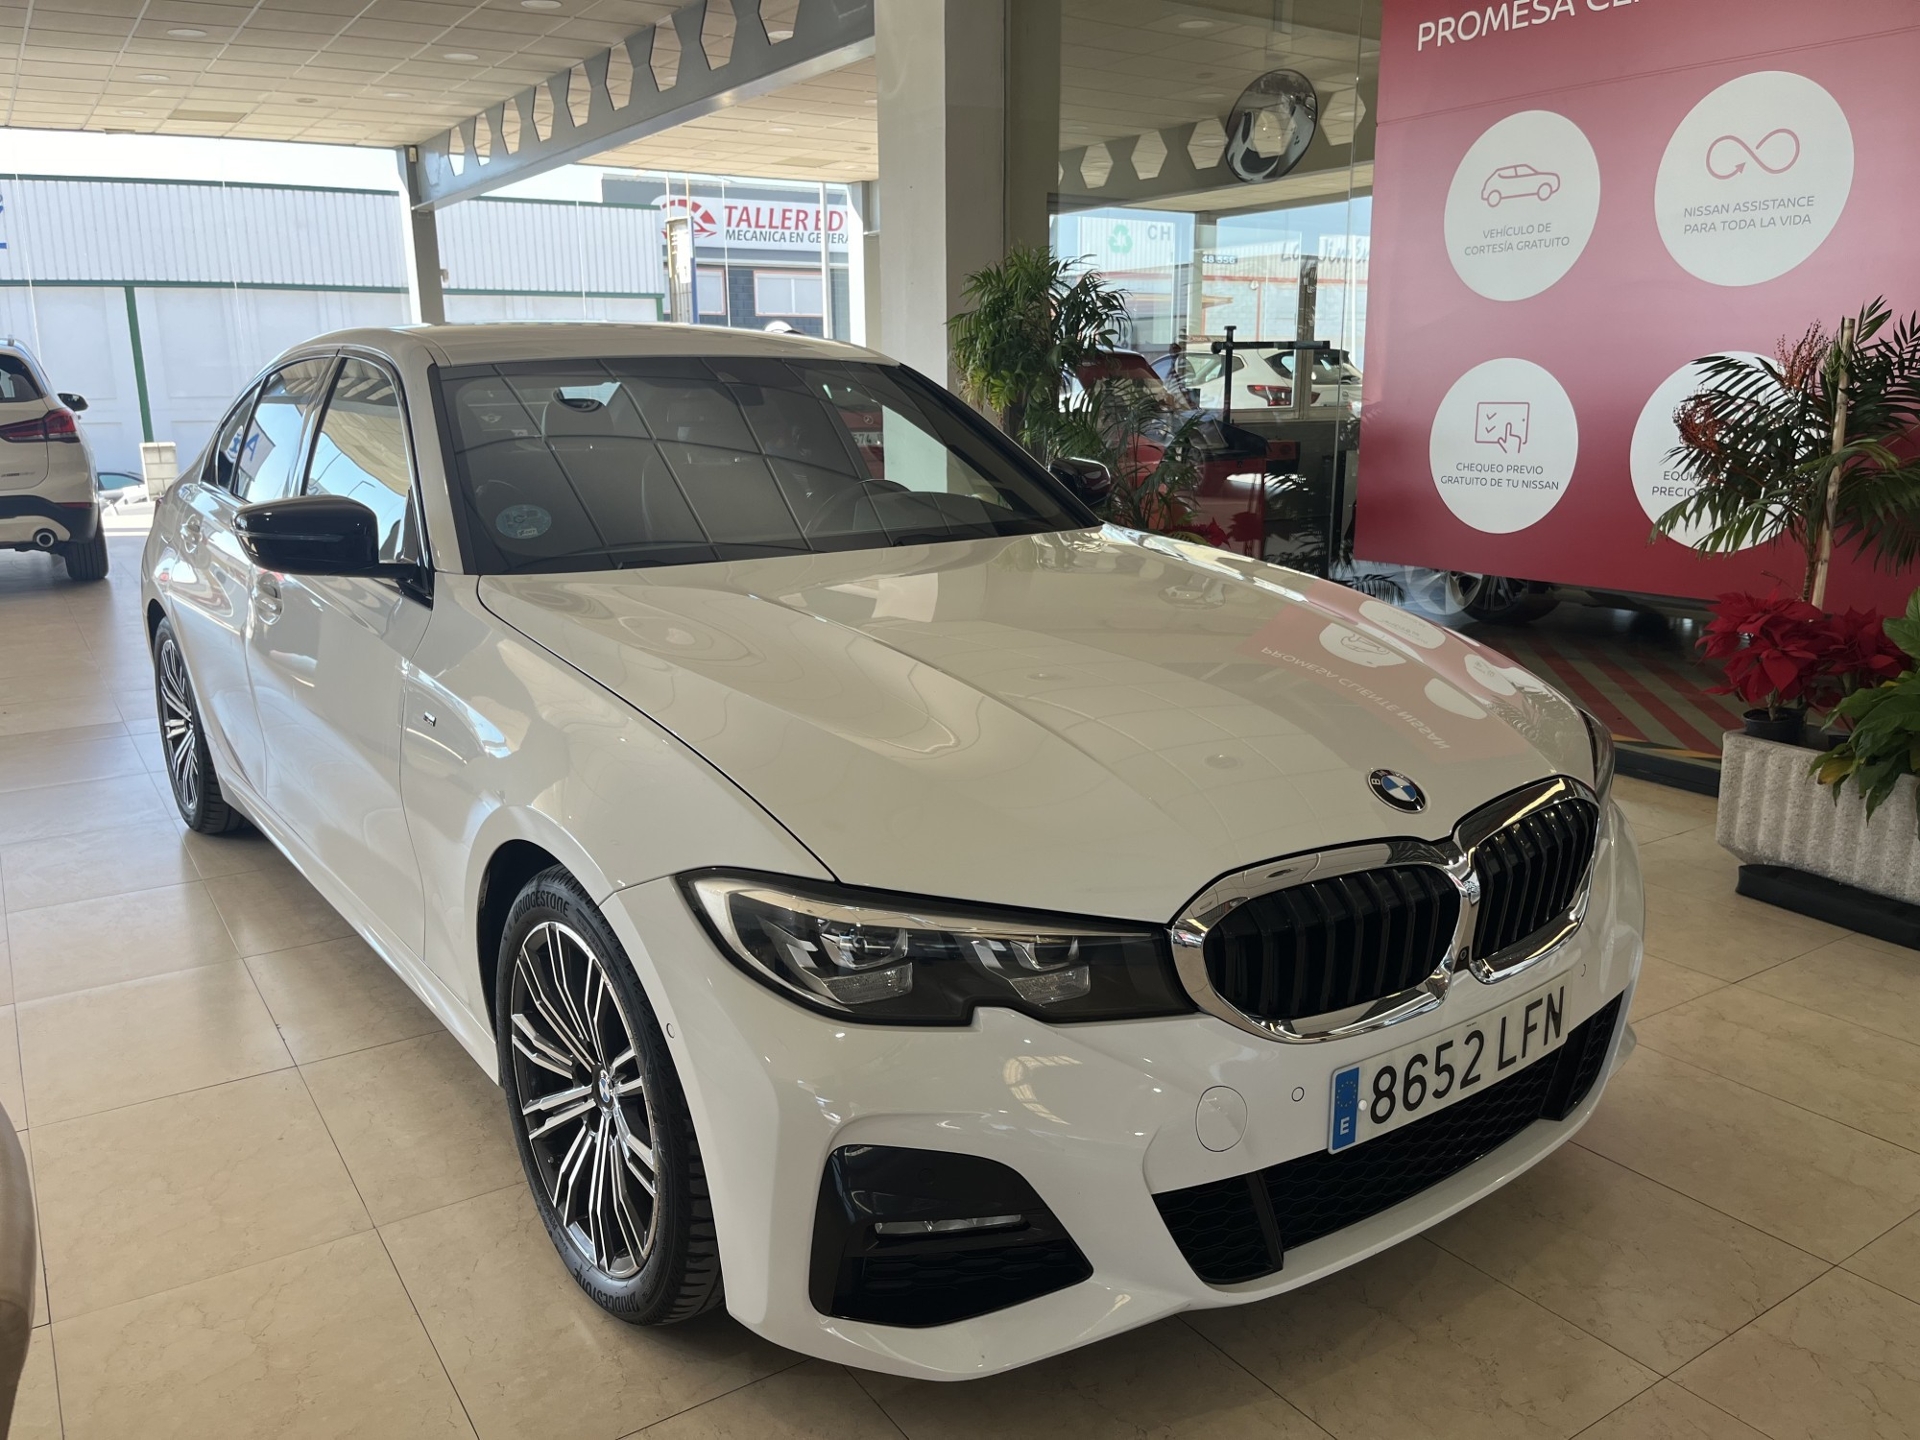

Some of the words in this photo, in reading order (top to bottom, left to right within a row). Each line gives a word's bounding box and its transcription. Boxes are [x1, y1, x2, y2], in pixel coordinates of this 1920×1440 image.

[1417, 0, 1576, 51] PROMESA
[1683, 203, 1730, 218] NISSAN
[1732, 195, 1815, 213] ASSISTANCE
[724, 205, 808, 231] TALLER
[814, 209, 848, 232] ED
[1683, 221, 1717, 235] PARA
[1720, 218, 1757, 231] TODA
[1760, 216, 1777, 228] LA
[1780, 213, 1812, 226] VIDA
[725, 229, 787, 243] MECANICA
[789, 231, 804, 243] EN
[1482, 224, 1535, 239] VEHÍCULO
[1537, 222, 1552, 234] DE
[1464, 240, 1514, 256] CORTESÍA
[1516, 236, 1570, 251] GRATUITO
[1456, 462, 1504, 473] CHEQUEO
[1506, 464, 1544, 475] PREVIO
[1440, 475, 1488, 487] GRATUITO
[1490, 477, 1503, 488] DE
[1505, 478, 1519, 488] TU
[1521, 479, 1559, 490] NISSAN
[513, 889, 570, 924] BRIDGESTONE
[1370, 1029, 1485, 1125] 8652
[1497, 985, 1565, 1072] LFN
[1339, 1116, 1350, 1136] E
